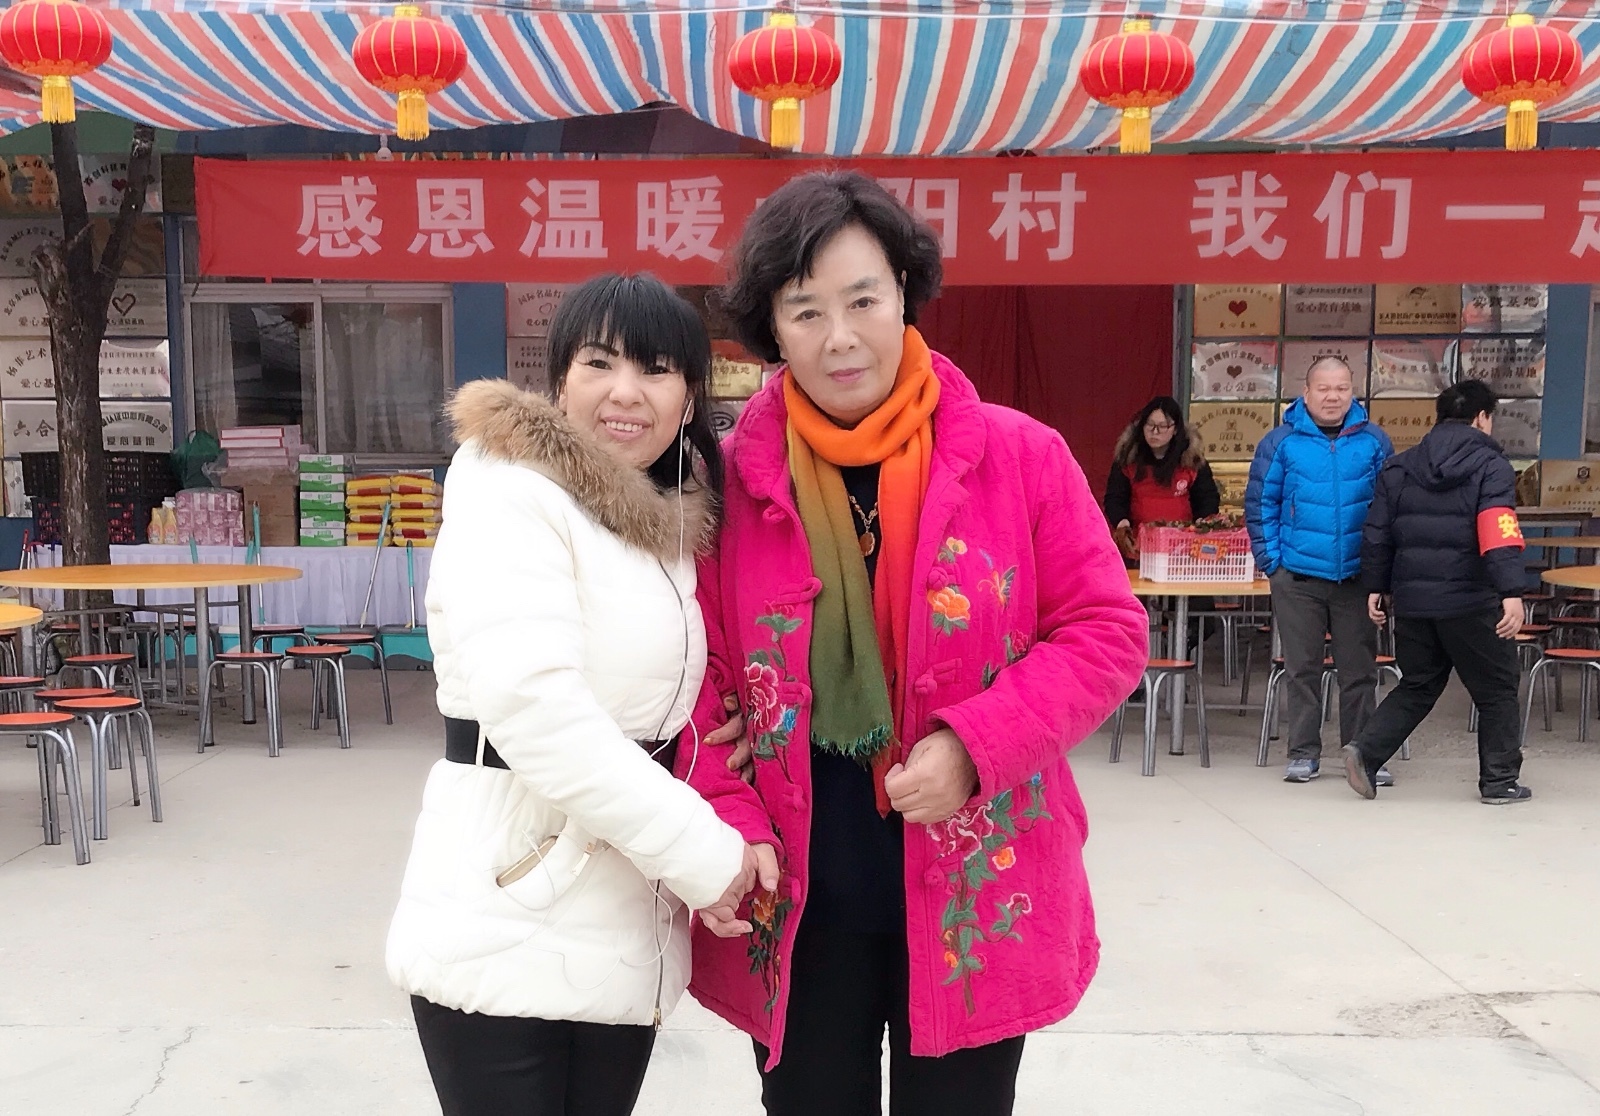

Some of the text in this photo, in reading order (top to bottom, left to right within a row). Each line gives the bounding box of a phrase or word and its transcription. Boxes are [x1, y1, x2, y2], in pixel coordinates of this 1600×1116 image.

[296, 174, 1087, 262] 感恩温暖阳村
[1497, 512, 1523, 539] 安
